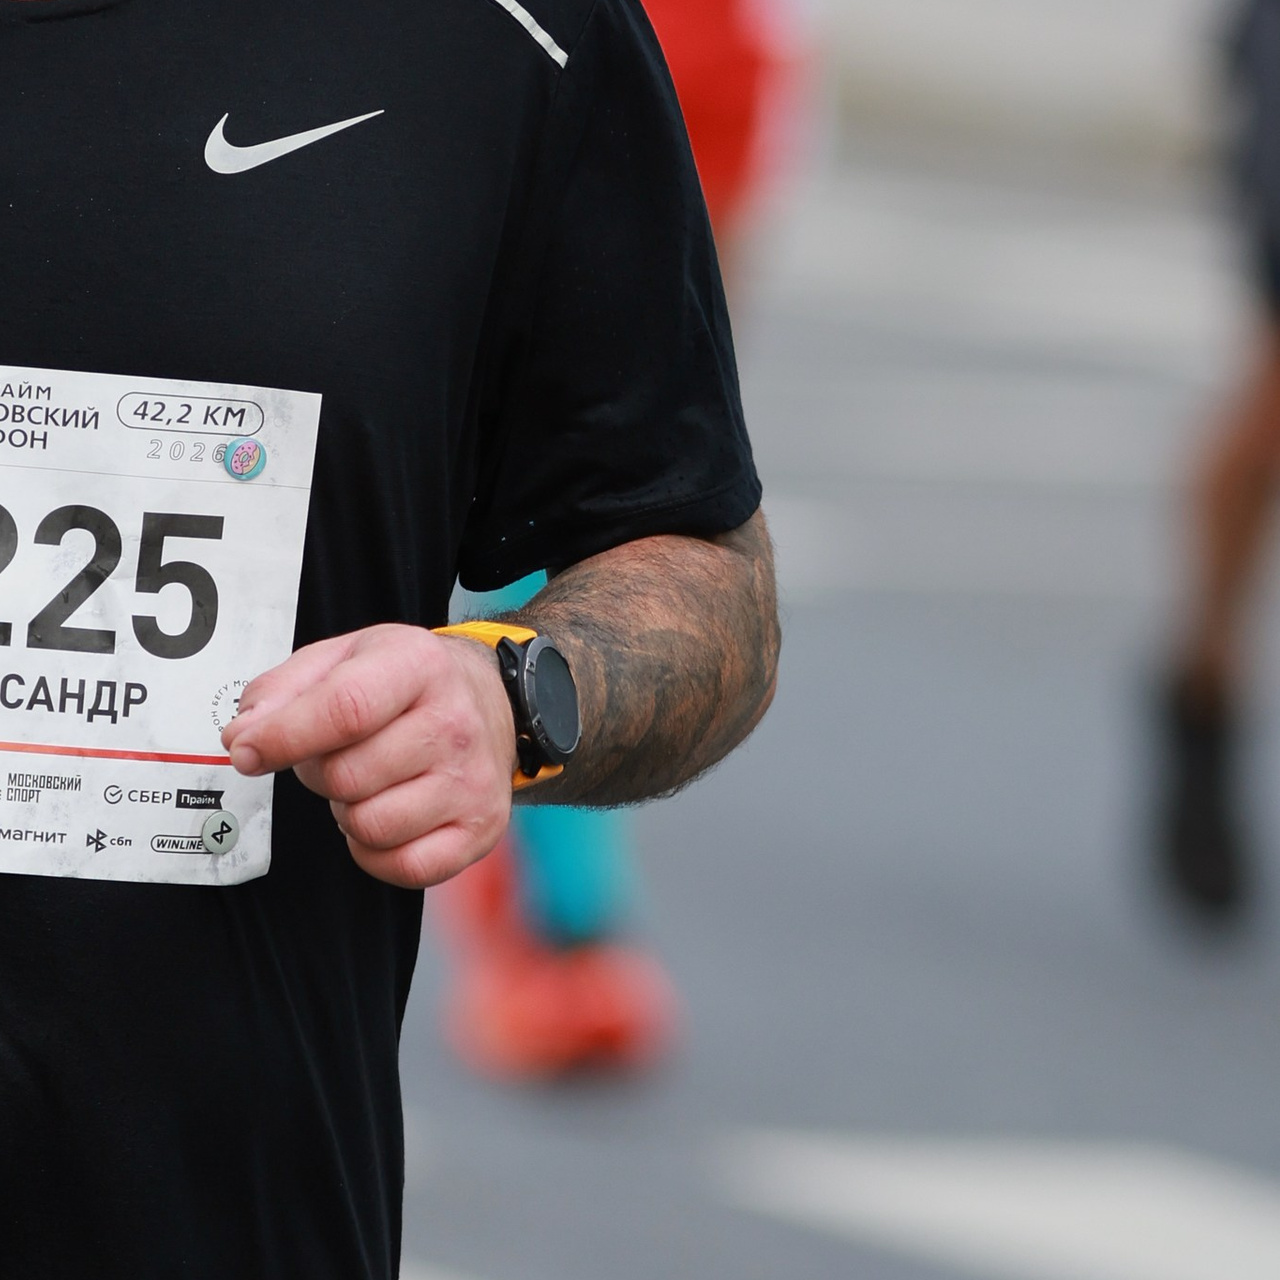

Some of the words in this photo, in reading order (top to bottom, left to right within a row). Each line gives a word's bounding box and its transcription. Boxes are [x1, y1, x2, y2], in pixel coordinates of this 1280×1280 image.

[133, 400, 193, 426] 42,2
[202, 405, 247, 428] КМ
[7, 772, 82, 792] МОСКОВСКИЙ
[6, 787, 42, 804] СПОРТ
[127, 789, 173, 804] СБЕР
[180, 793, 216, 806] Прайм
[109, 836, 133, 847] сбп
[156, 838, 203, 851] WINLINE
